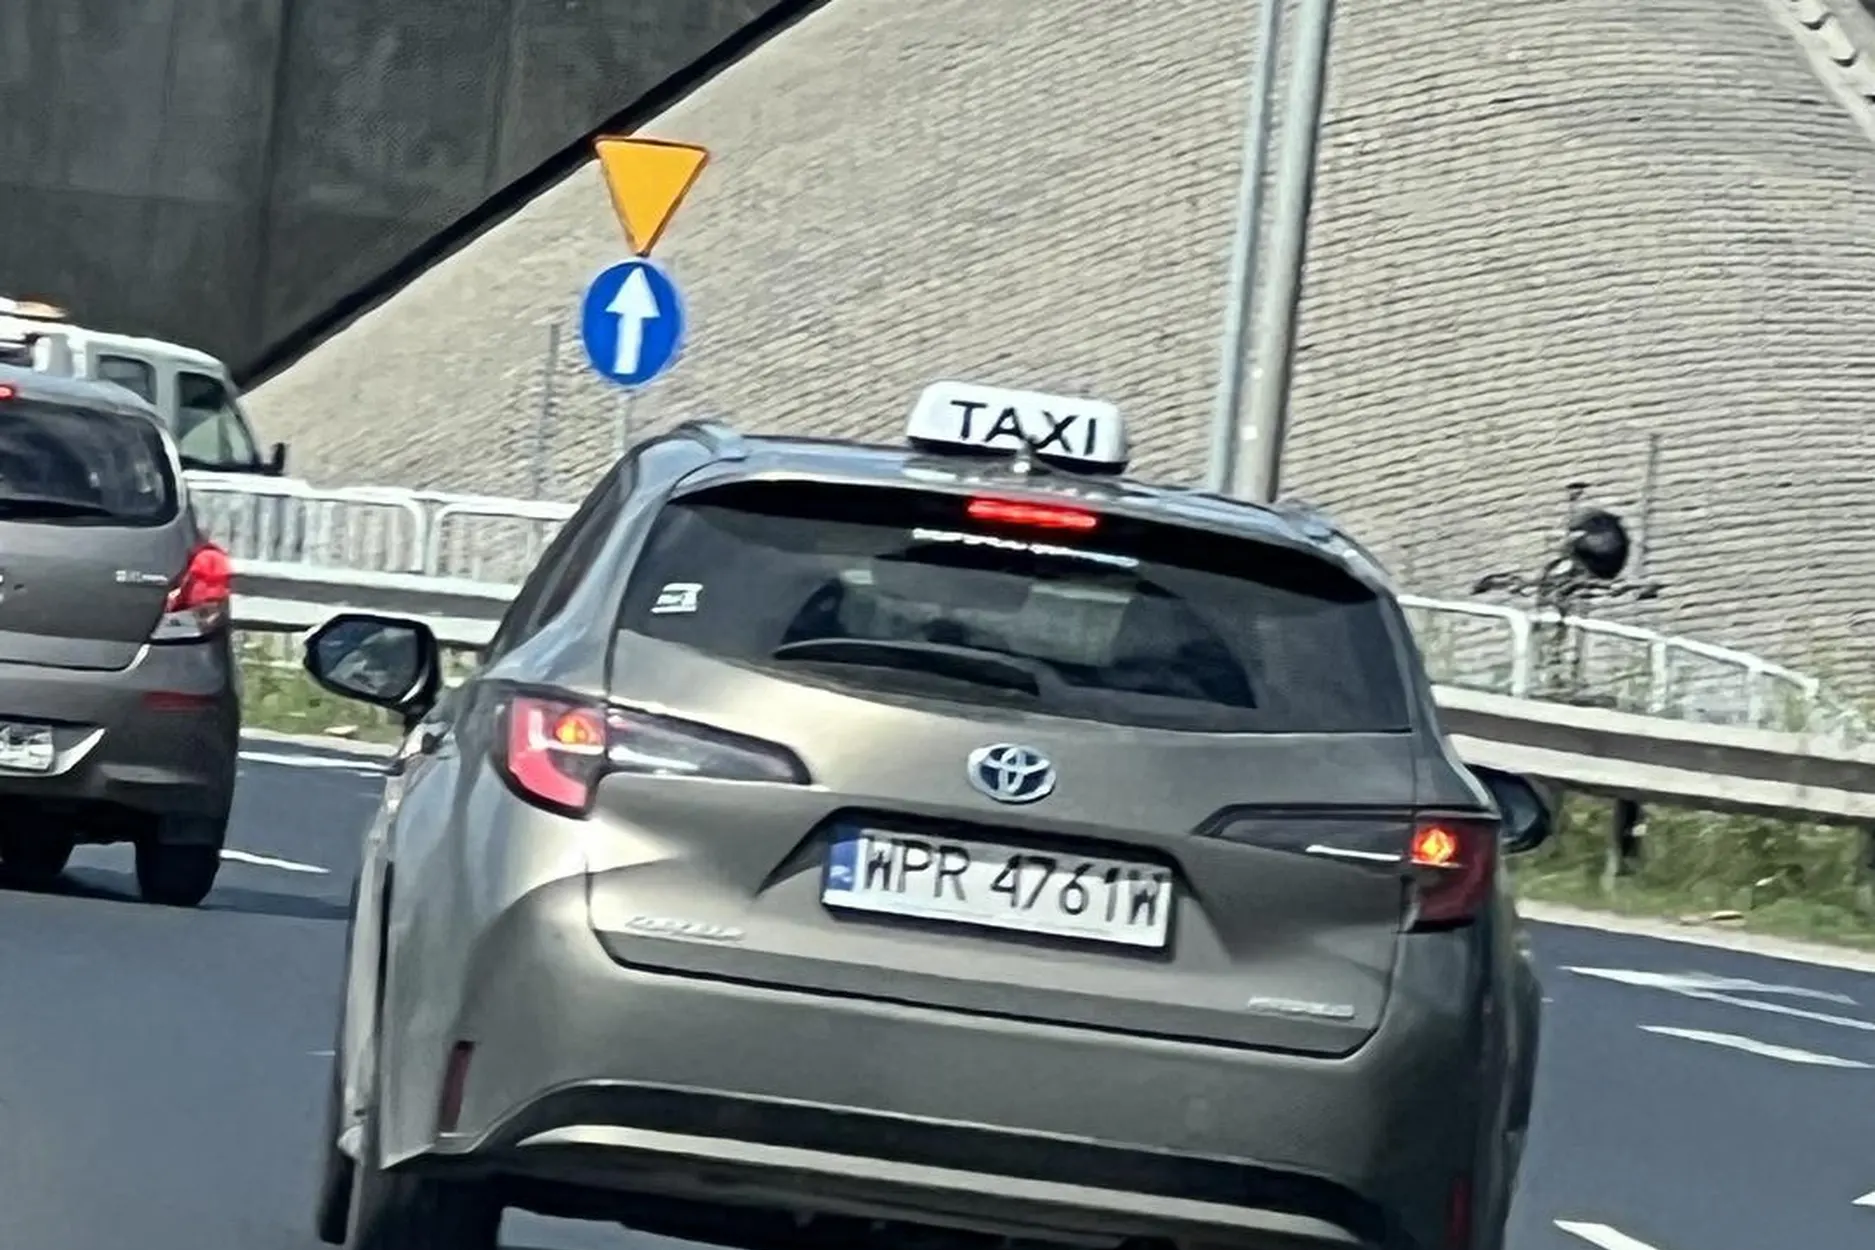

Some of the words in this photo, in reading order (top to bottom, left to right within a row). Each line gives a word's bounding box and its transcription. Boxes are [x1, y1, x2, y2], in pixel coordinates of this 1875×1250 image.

[950, 400, 1097, 455] TAXI
[862, 835, 971, 901] WPR
[990, 853, 1166, 926] 4761W
